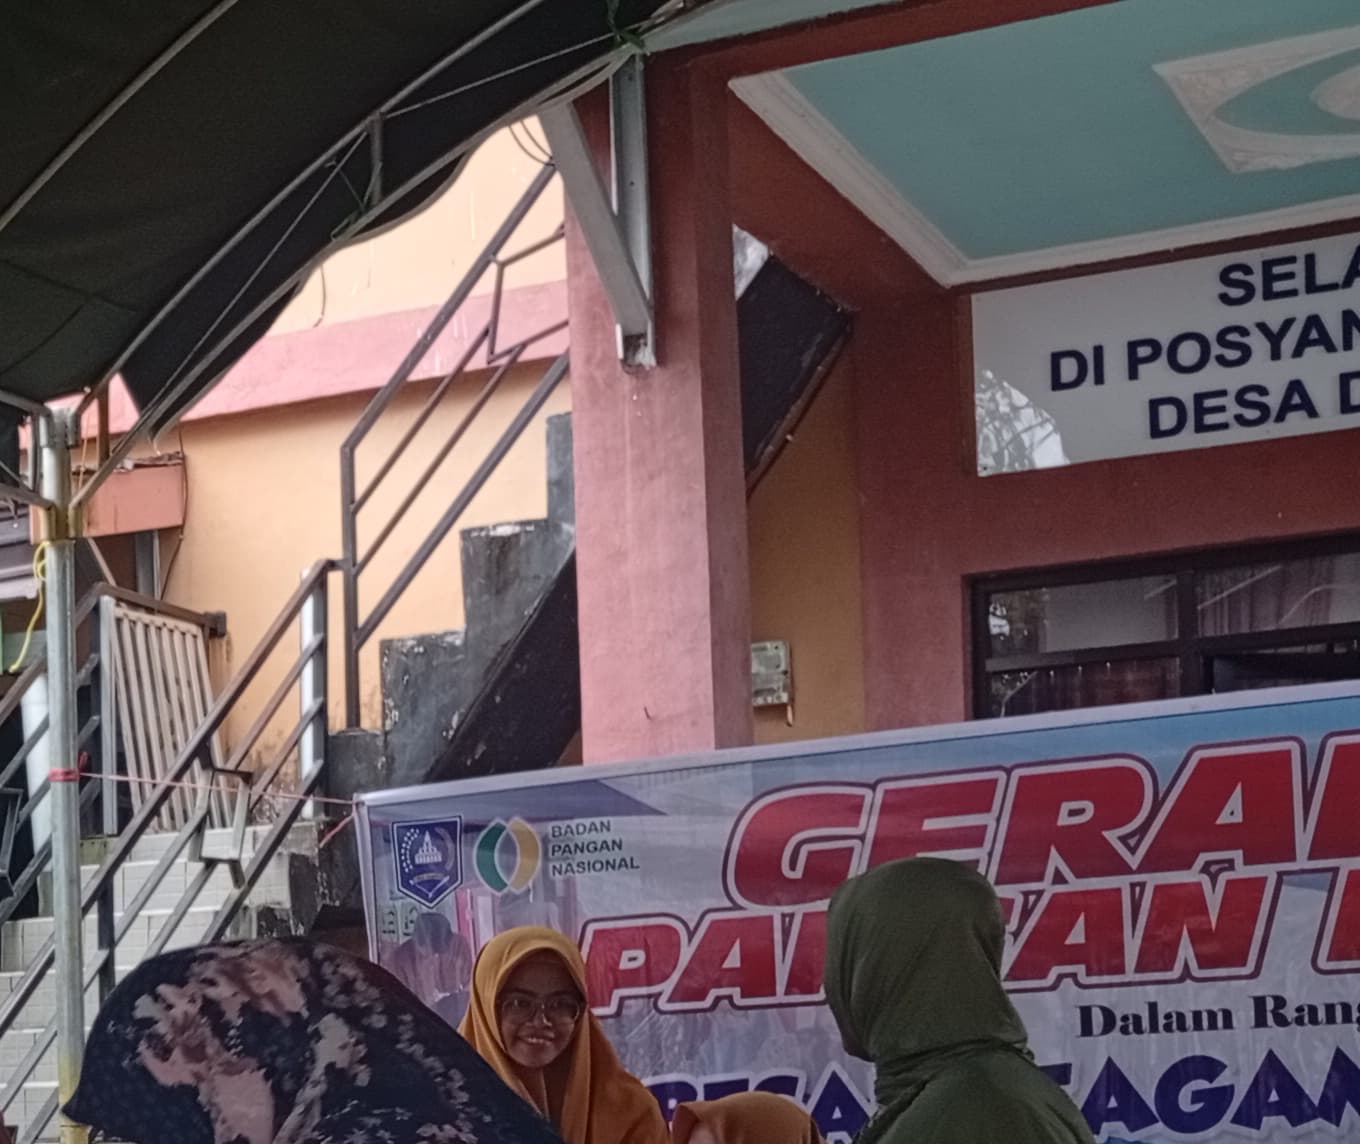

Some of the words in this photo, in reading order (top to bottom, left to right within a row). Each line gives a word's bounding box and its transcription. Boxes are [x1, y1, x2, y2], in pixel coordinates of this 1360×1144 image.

[1050, 344, 1105, 392] DI
[1148, 378, 1320, 440] DESA
[550, 820, 612, 839] BADAN
[550, 838, 624, 858] PANGAN
[550, 856, 641, 877] NASIONAL
[1075, 1000, 1235, 1039] Dalam
